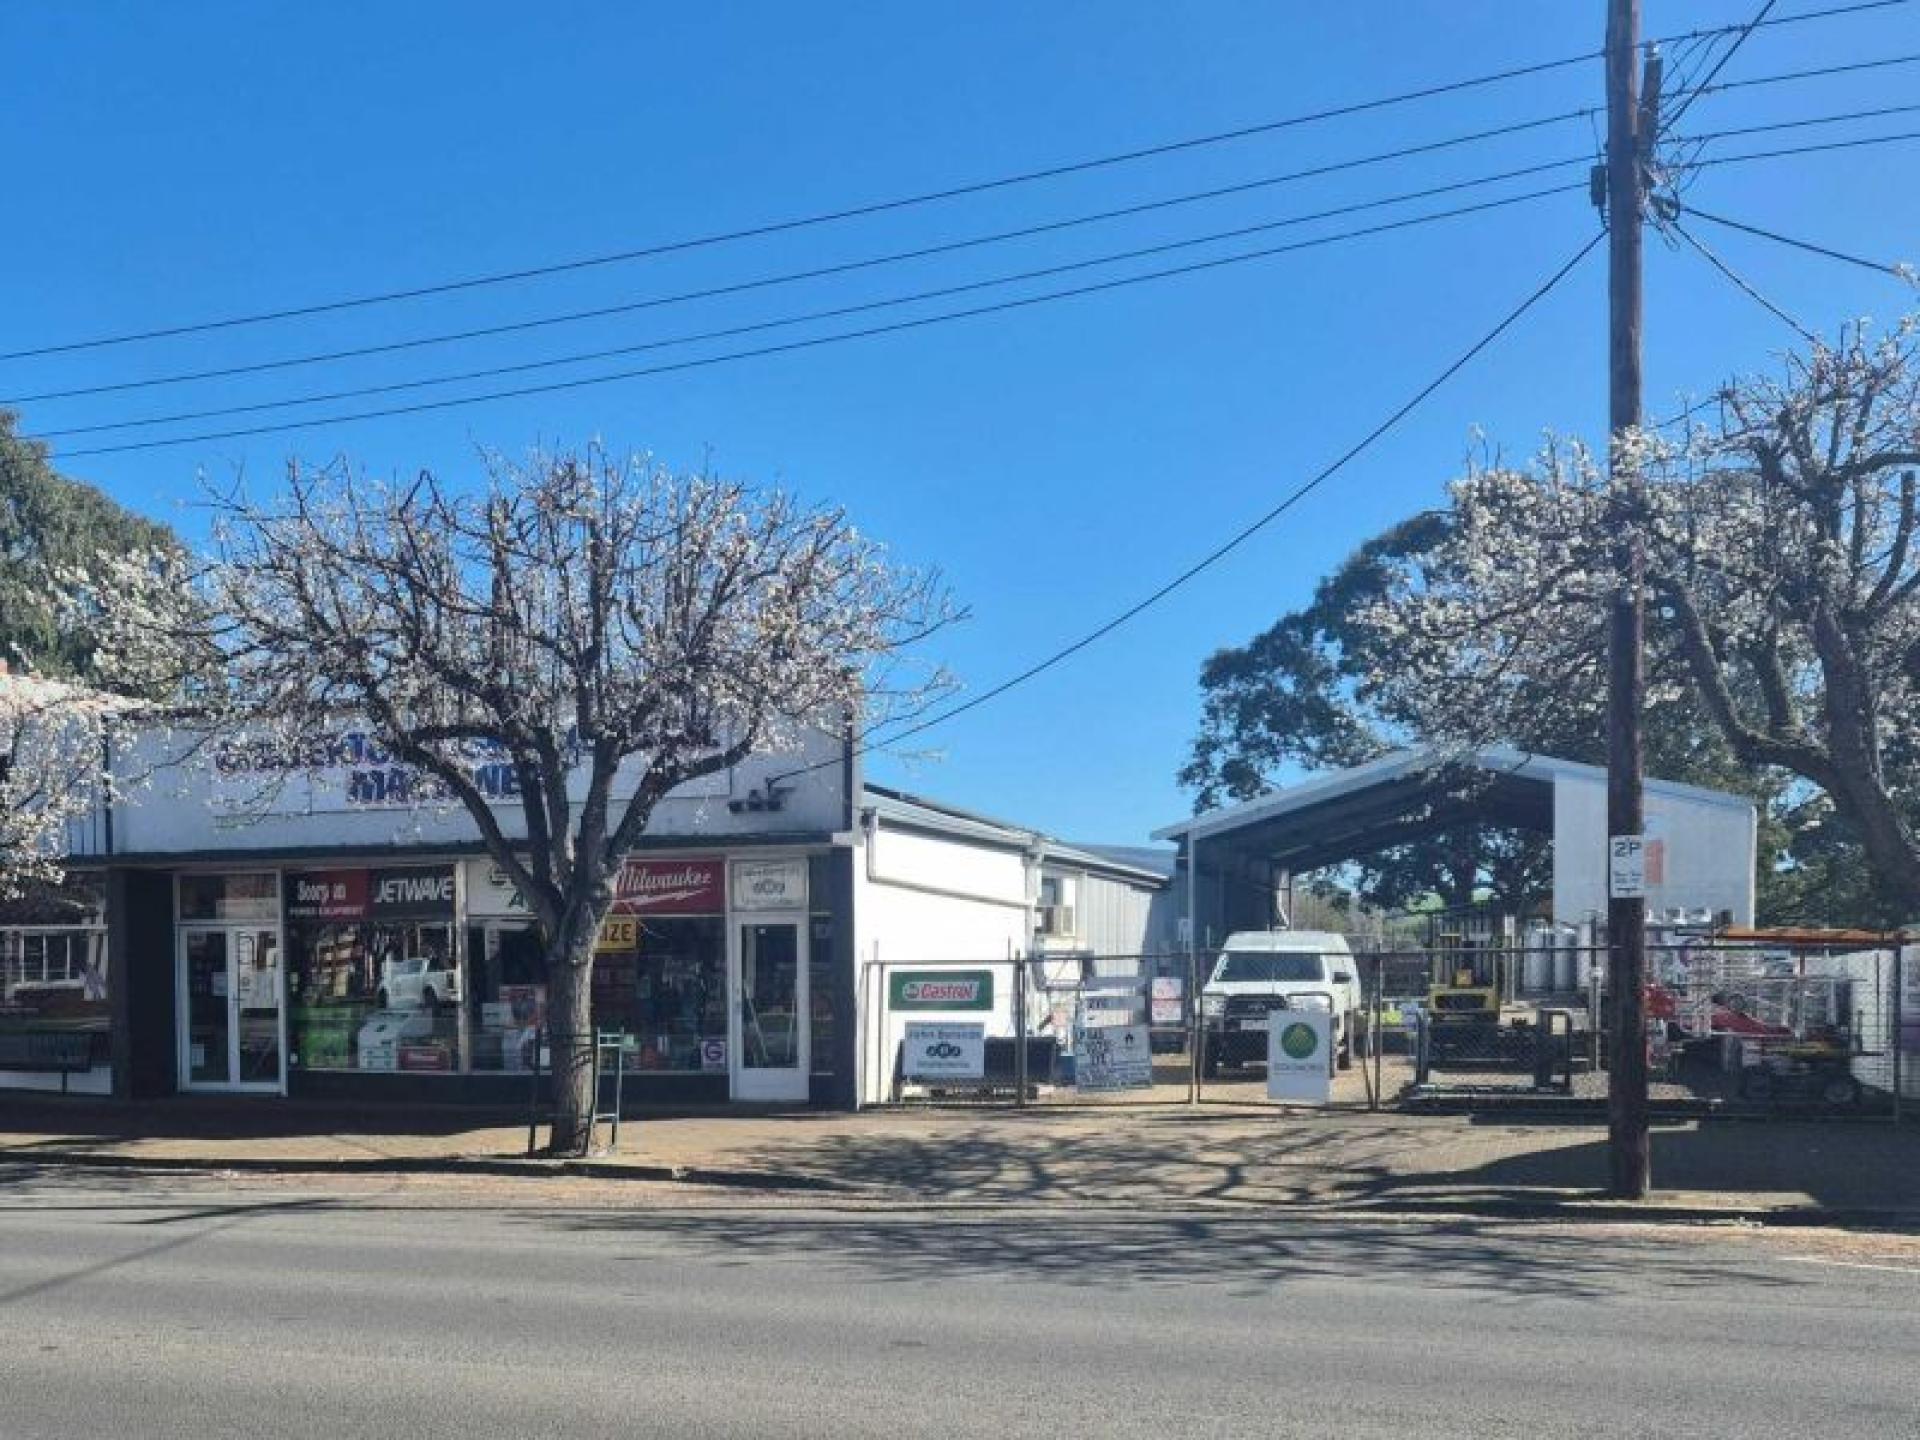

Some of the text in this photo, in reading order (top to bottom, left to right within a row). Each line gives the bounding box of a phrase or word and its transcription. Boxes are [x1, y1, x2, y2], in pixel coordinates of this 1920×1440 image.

[1614, 841, 1642, 858] 2P
[374, 876, 455, 903] JETWAVE
[921, 982, 974, 1000] Castrol
